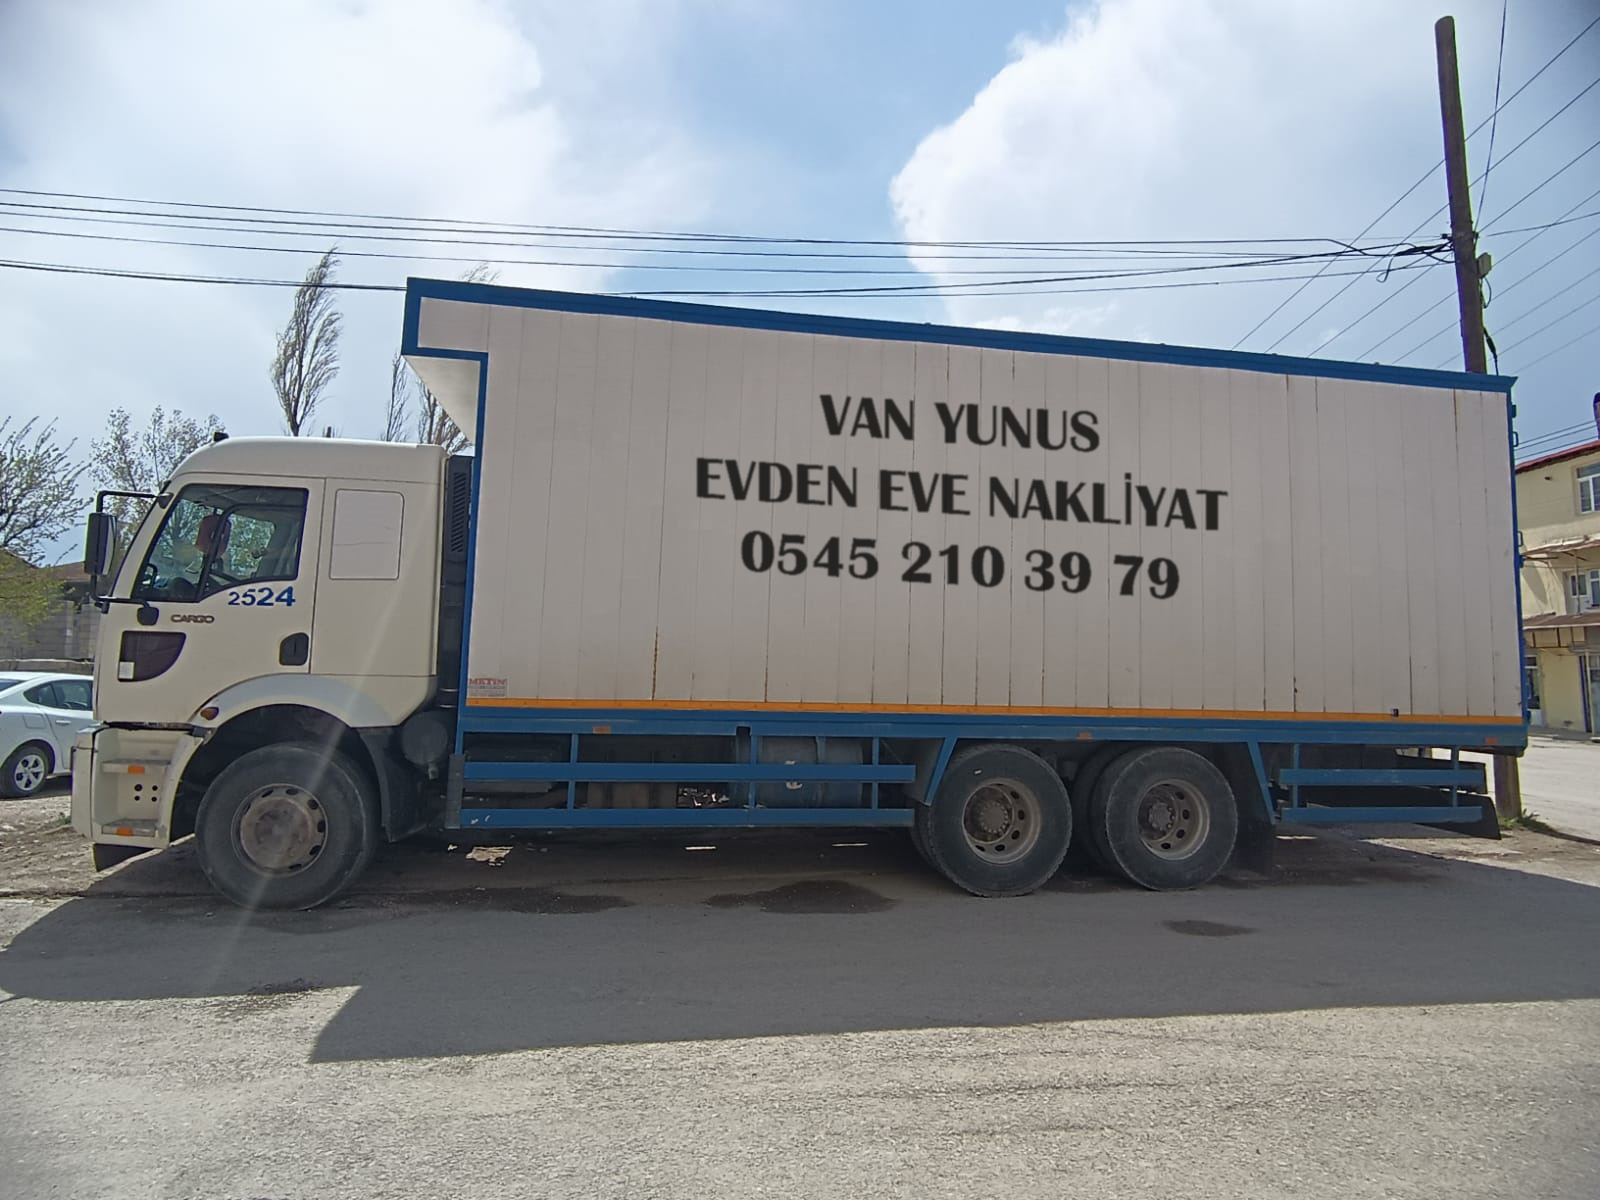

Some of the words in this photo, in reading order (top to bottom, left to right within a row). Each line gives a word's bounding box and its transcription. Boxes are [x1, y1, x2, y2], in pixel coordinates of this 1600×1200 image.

[820, 395, 914, 440] VAN
[935, 403, 1099, 452] YUNUS
[697, 458, 857, 507] EVDEN
[880, 470, 970, 515] EVE
[989, 473, 1228, 531] NAKLİYAT
[741, 531, 879, 579] 0545
[901, 542, 1004, 587] 210
[1025, 550, 1091, 593] 39
[1113, 555, 1179, 599] 79
[171, 615, 215, 623] CARGO
[228, 586, 296, 606] 2524
